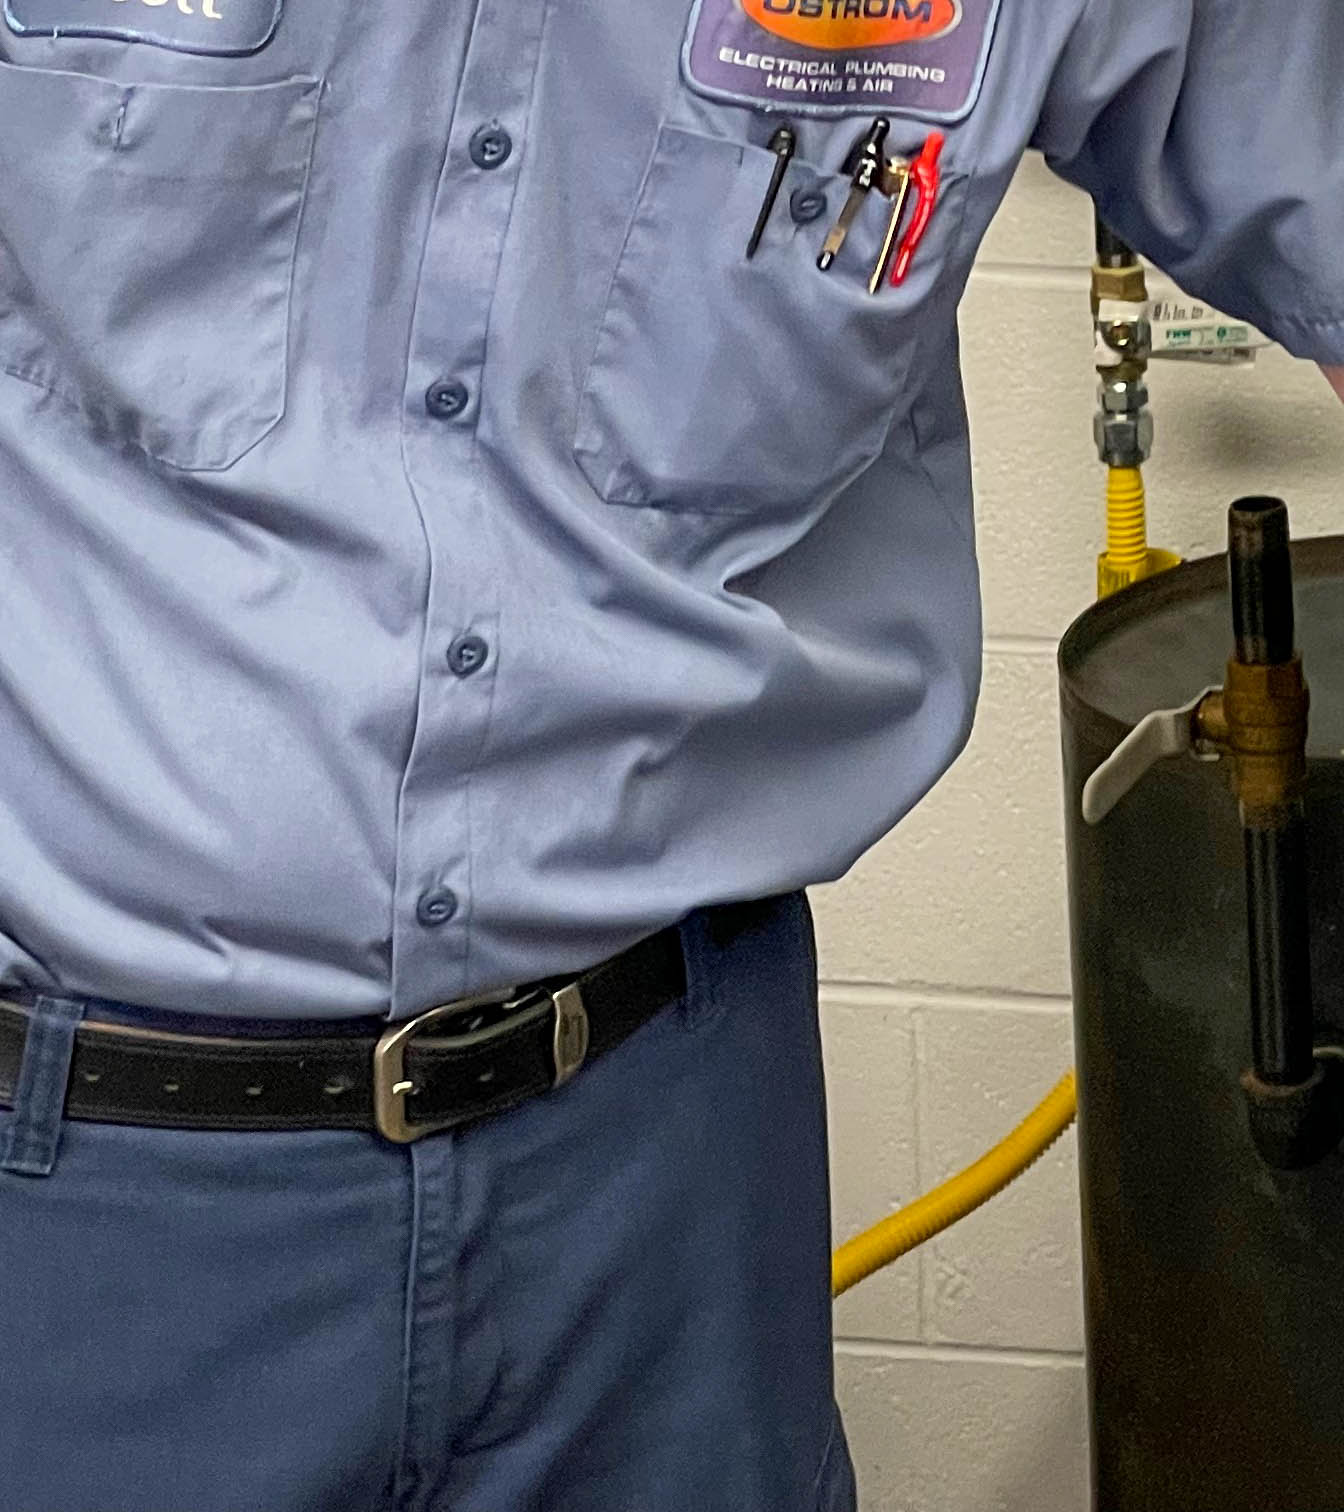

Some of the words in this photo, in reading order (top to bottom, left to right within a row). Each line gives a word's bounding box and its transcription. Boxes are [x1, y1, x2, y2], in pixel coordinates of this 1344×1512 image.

[718, 46, 837, 76] ELECTRICAL
[845, 61, 946, 83] PLUMBING
[766, 74, 842, 93] HEATING
[863, 79, 893, 94] AIR
